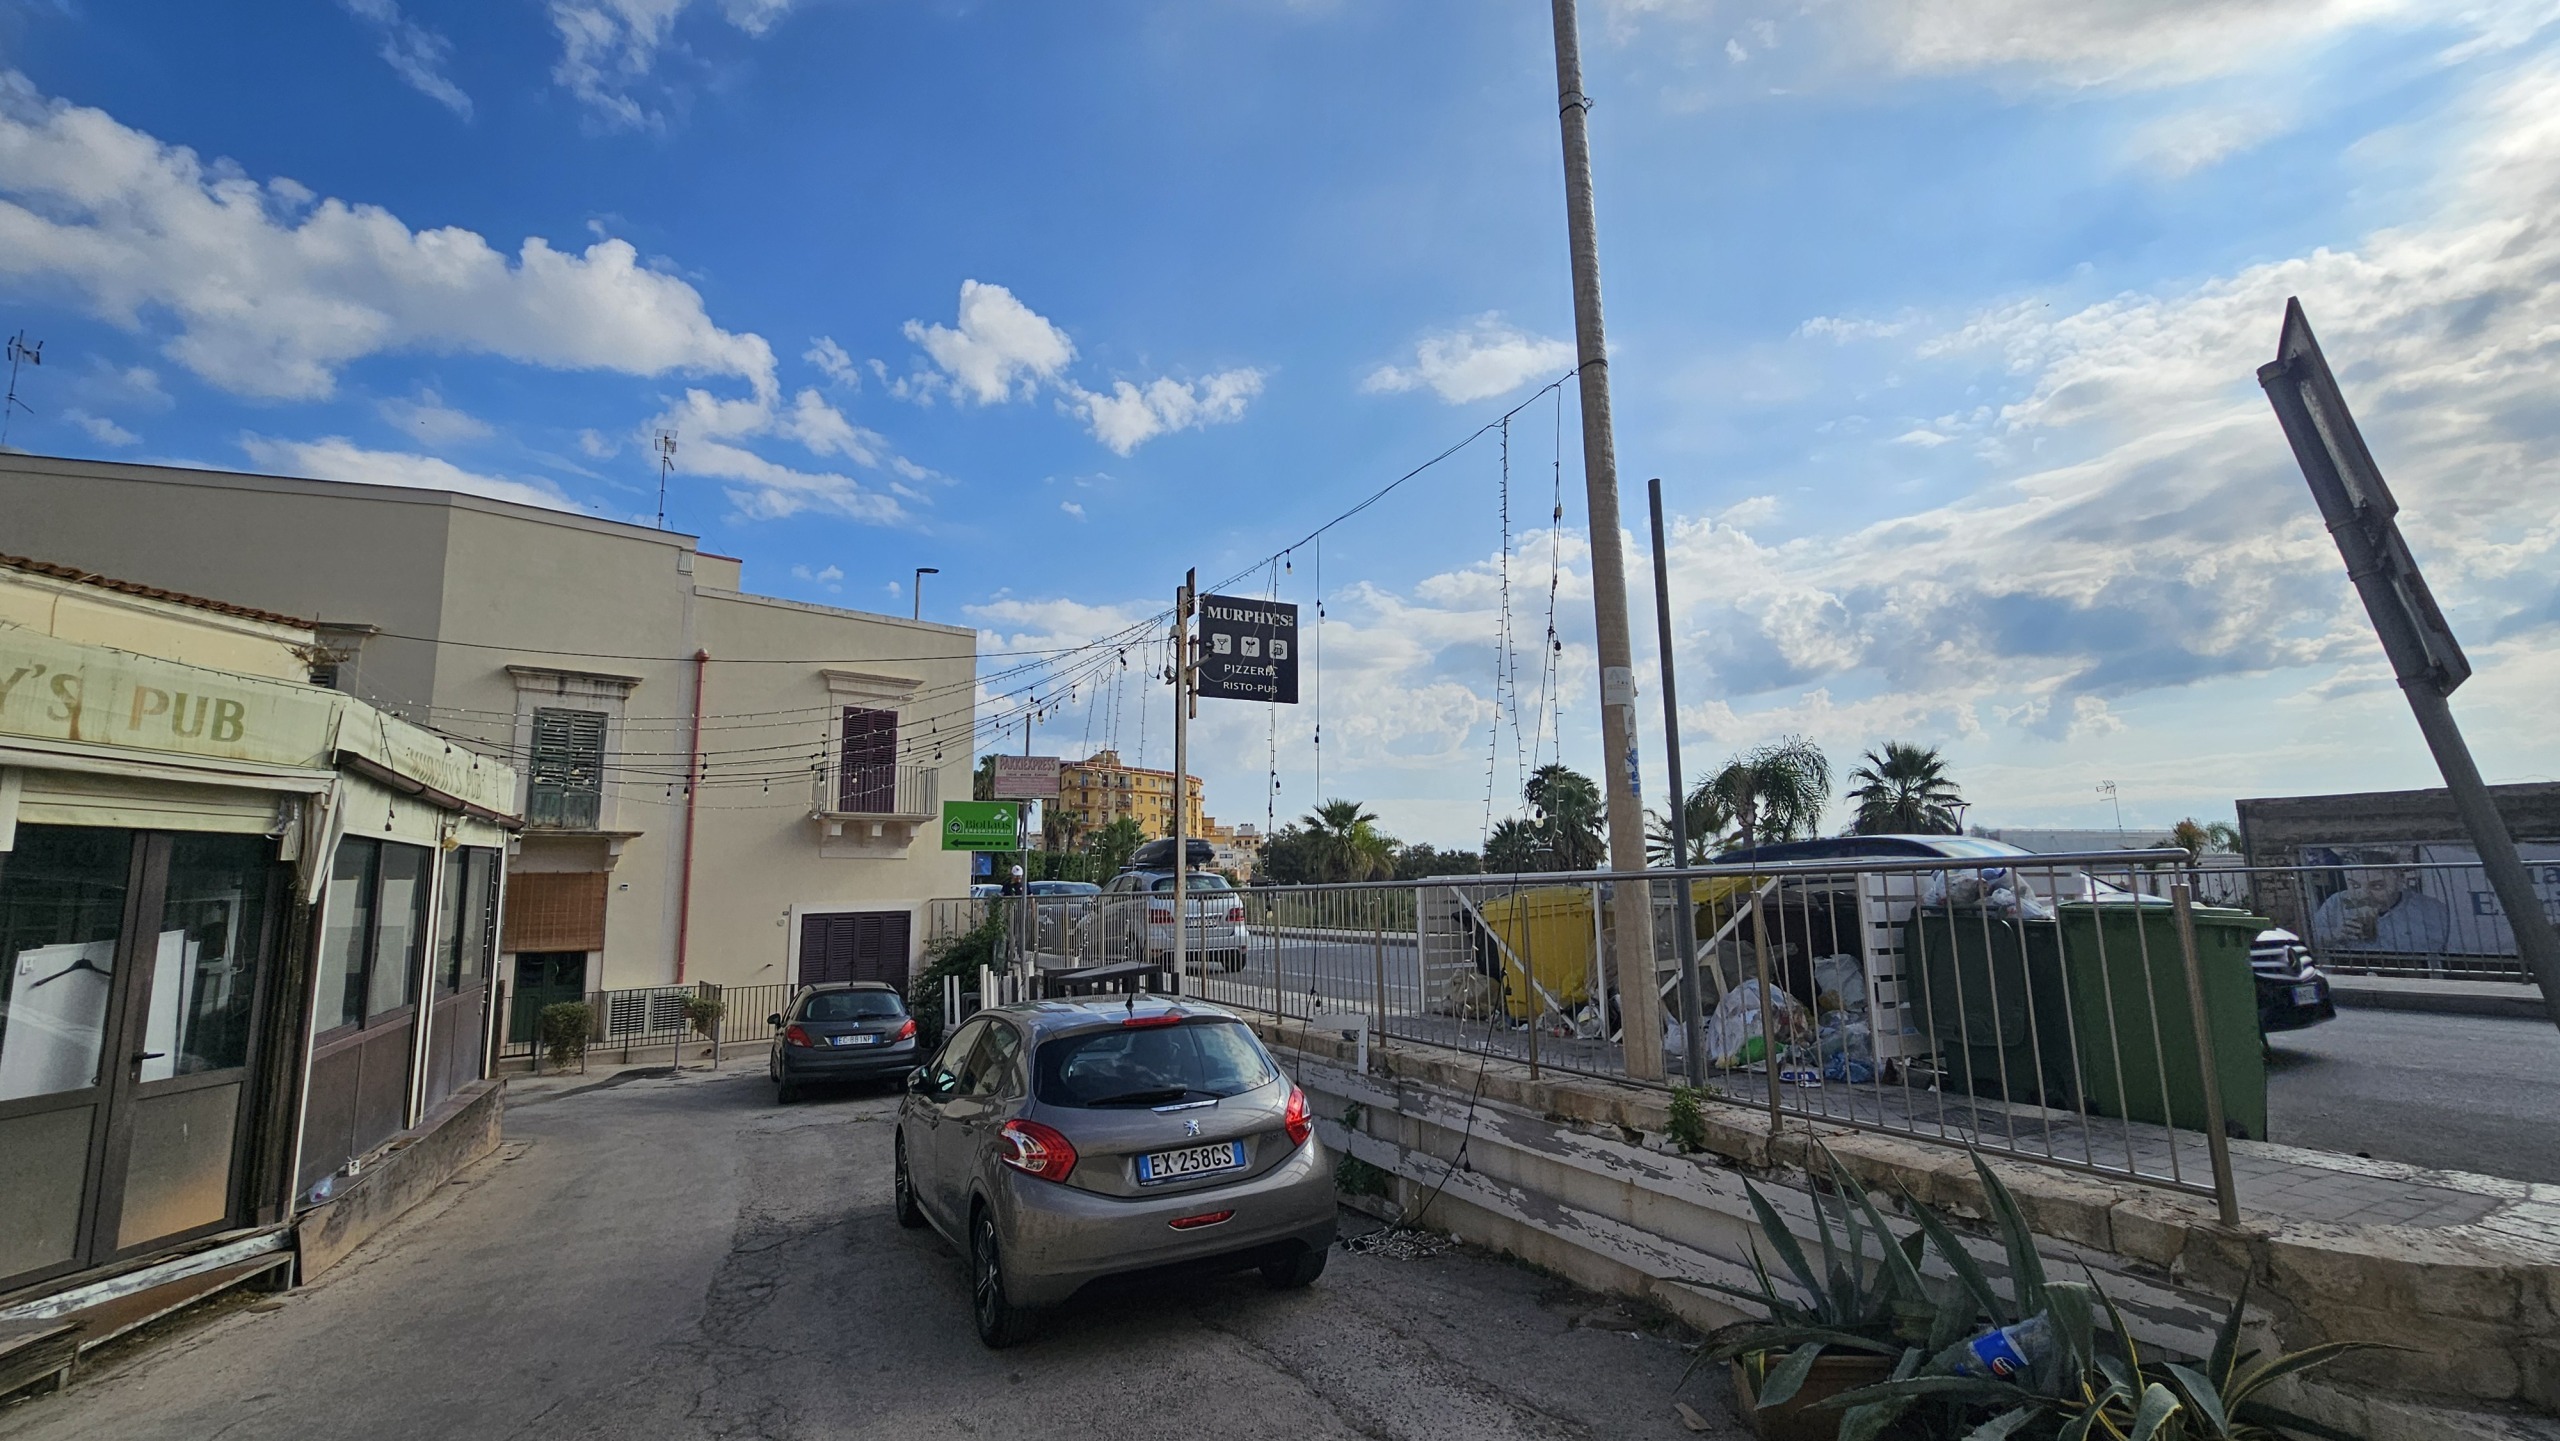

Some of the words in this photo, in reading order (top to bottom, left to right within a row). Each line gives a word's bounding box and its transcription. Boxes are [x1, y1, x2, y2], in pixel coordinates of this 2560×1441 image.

[1224, 664, 1276, 677] PIZZERIA
[1223, 681, 1278, 694] RISTO-PUB
[129, 686, 245, 743] PUB
[1150, 1153, 1174, 1176] EX
[1178, 1145, 1232, 1172] 258GS
